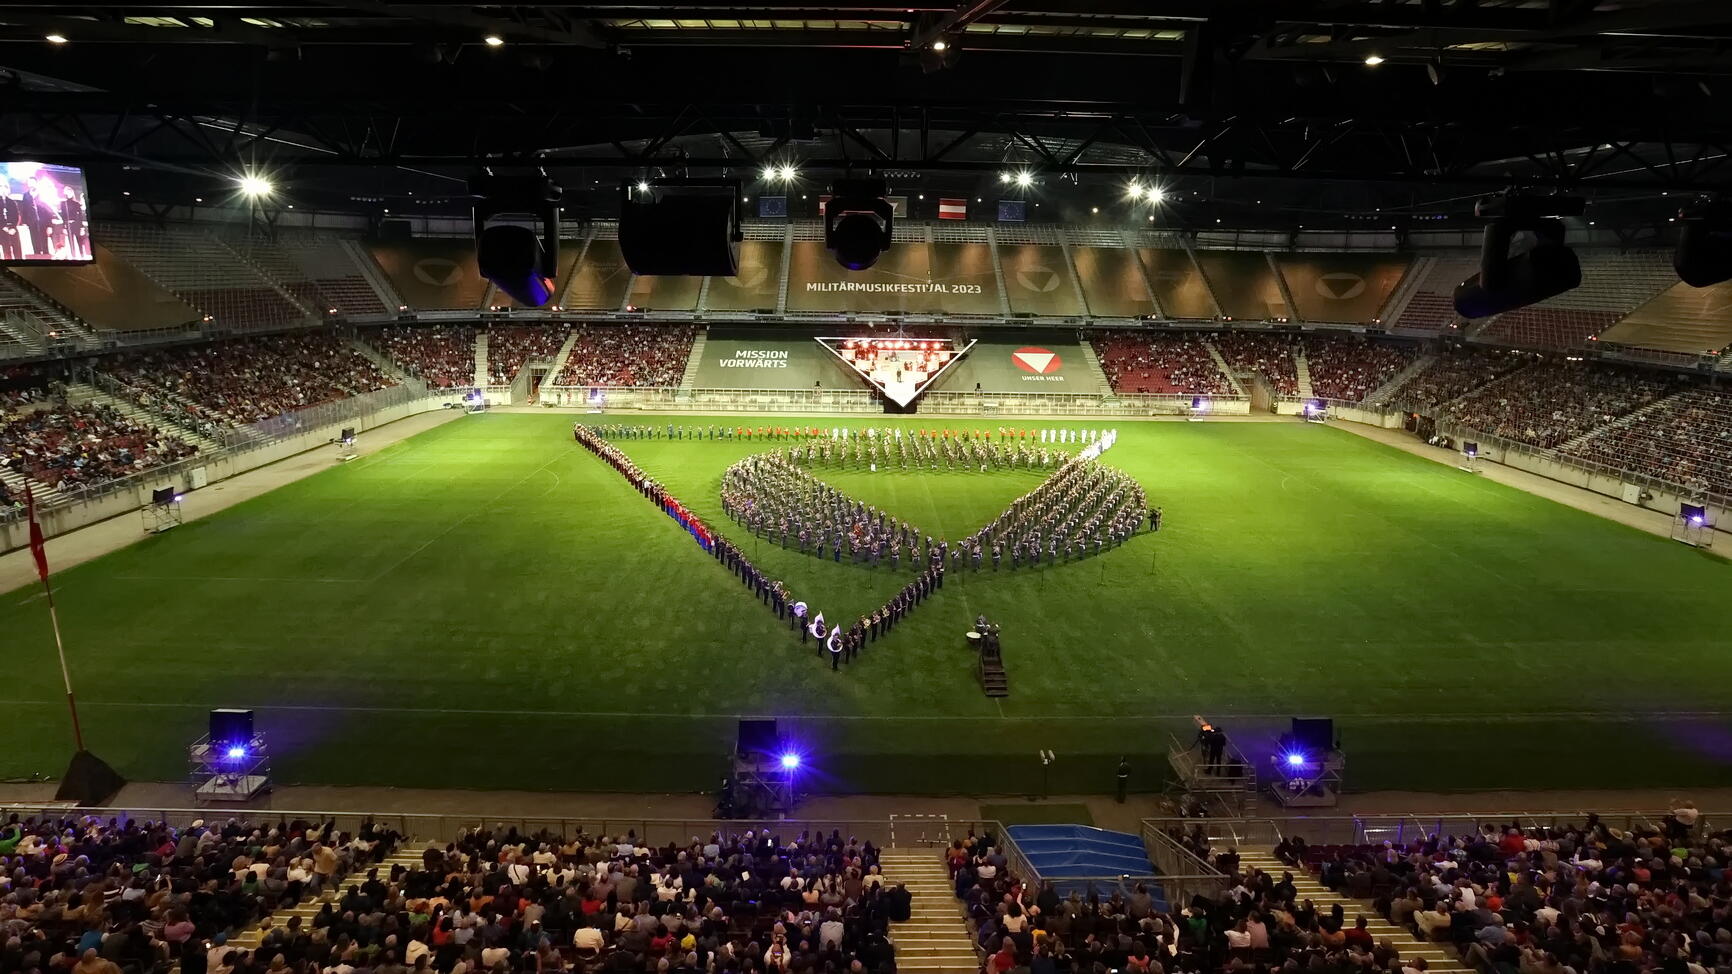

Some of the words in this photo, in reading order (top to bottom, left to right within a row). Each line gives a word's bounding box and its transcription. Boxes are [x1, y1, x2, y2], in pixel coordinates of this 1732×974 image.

[806, 281, 949, 293] MILITÄRMUSIKFESTIVAL
[952, 284, 982, 294] 2023
[735, 350, 789, 359] MISSION
[719, 358, 787, 368] VORWÄRTS
